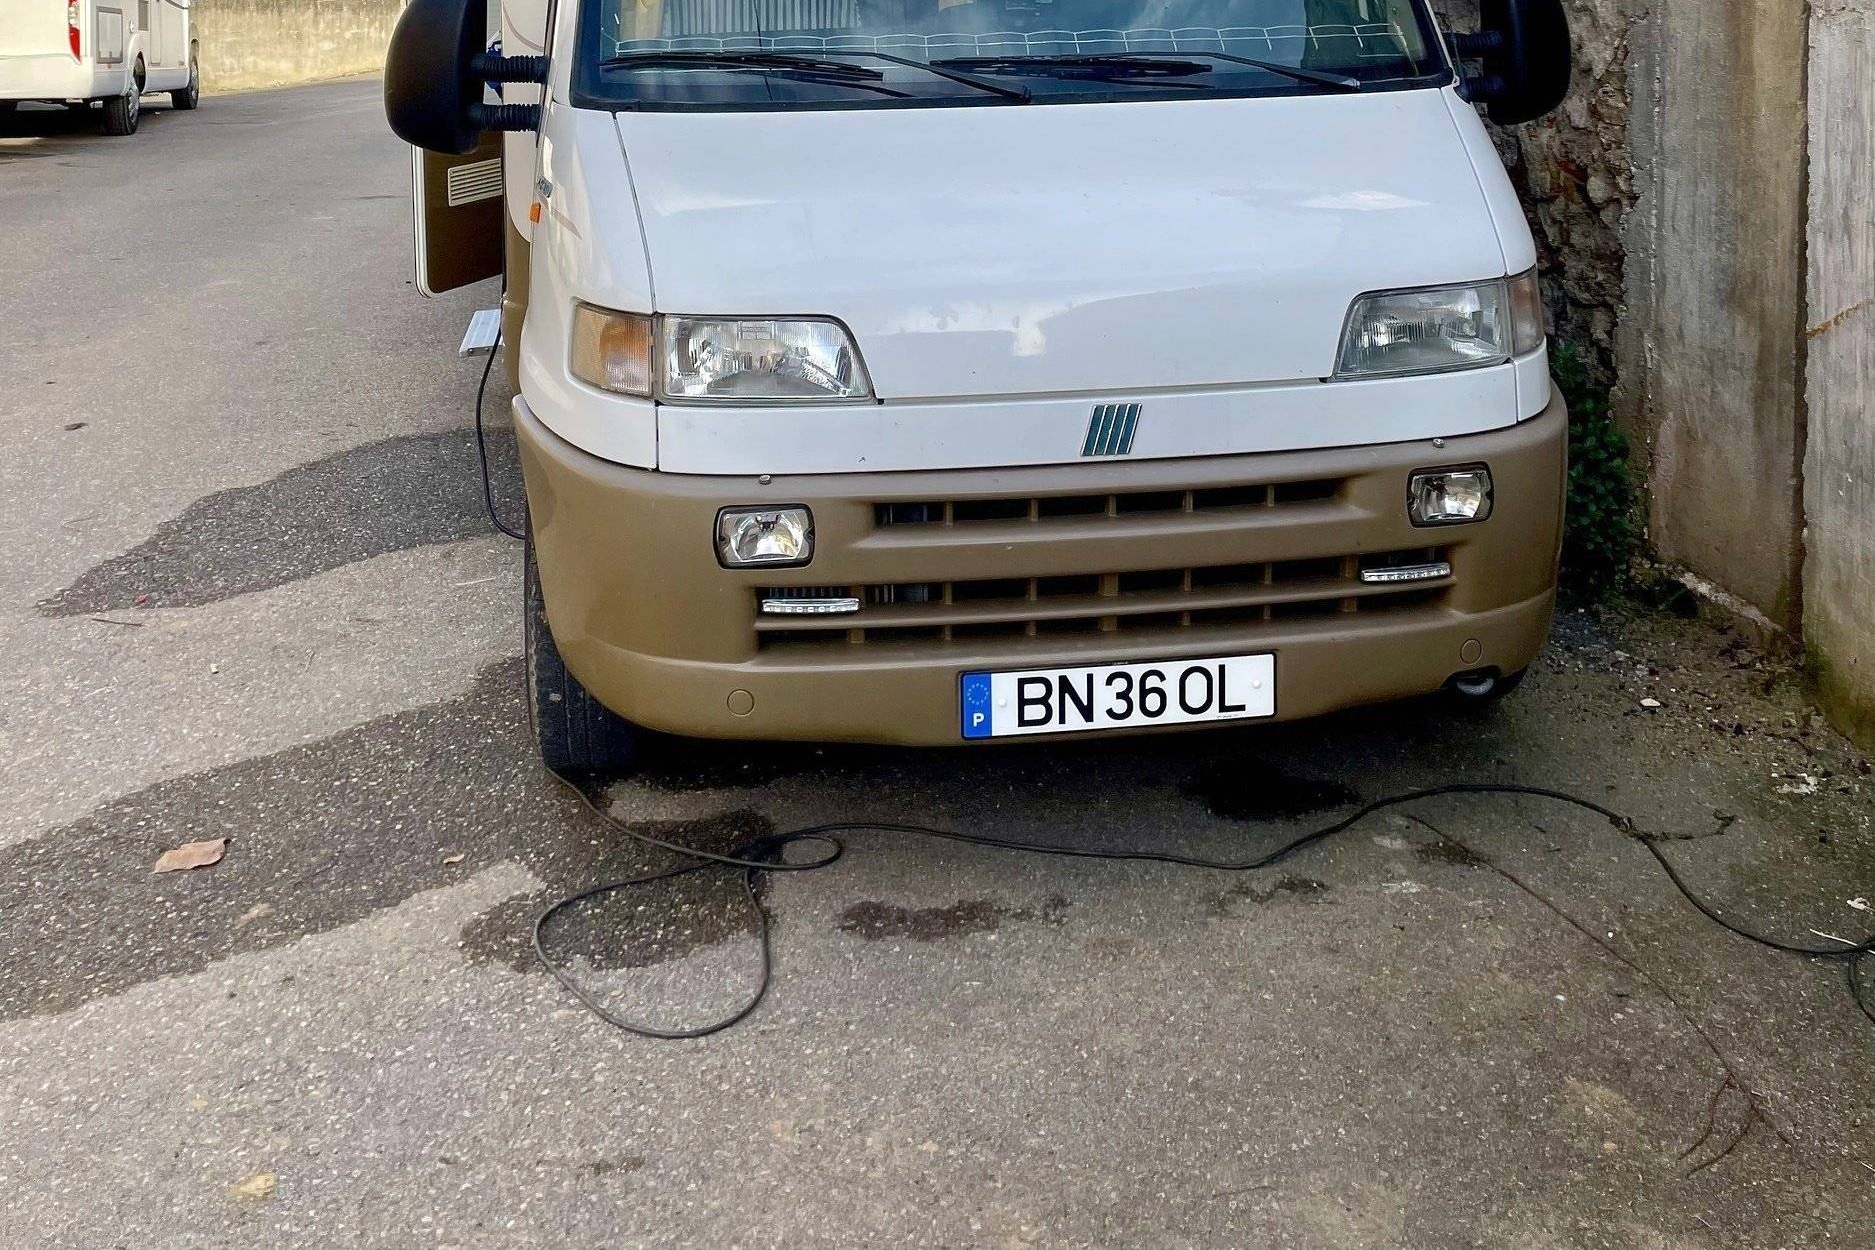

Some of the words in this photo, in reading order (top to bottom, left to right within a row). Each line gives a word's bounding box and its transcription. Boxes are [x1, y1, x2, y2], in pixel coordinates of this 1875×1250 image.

[1016, 672, 1094, 728] BN
[1104, 669, 1167, 721] 36
[1178, 664, 1246, 716] OL
[973, 713, 985, 727] P
